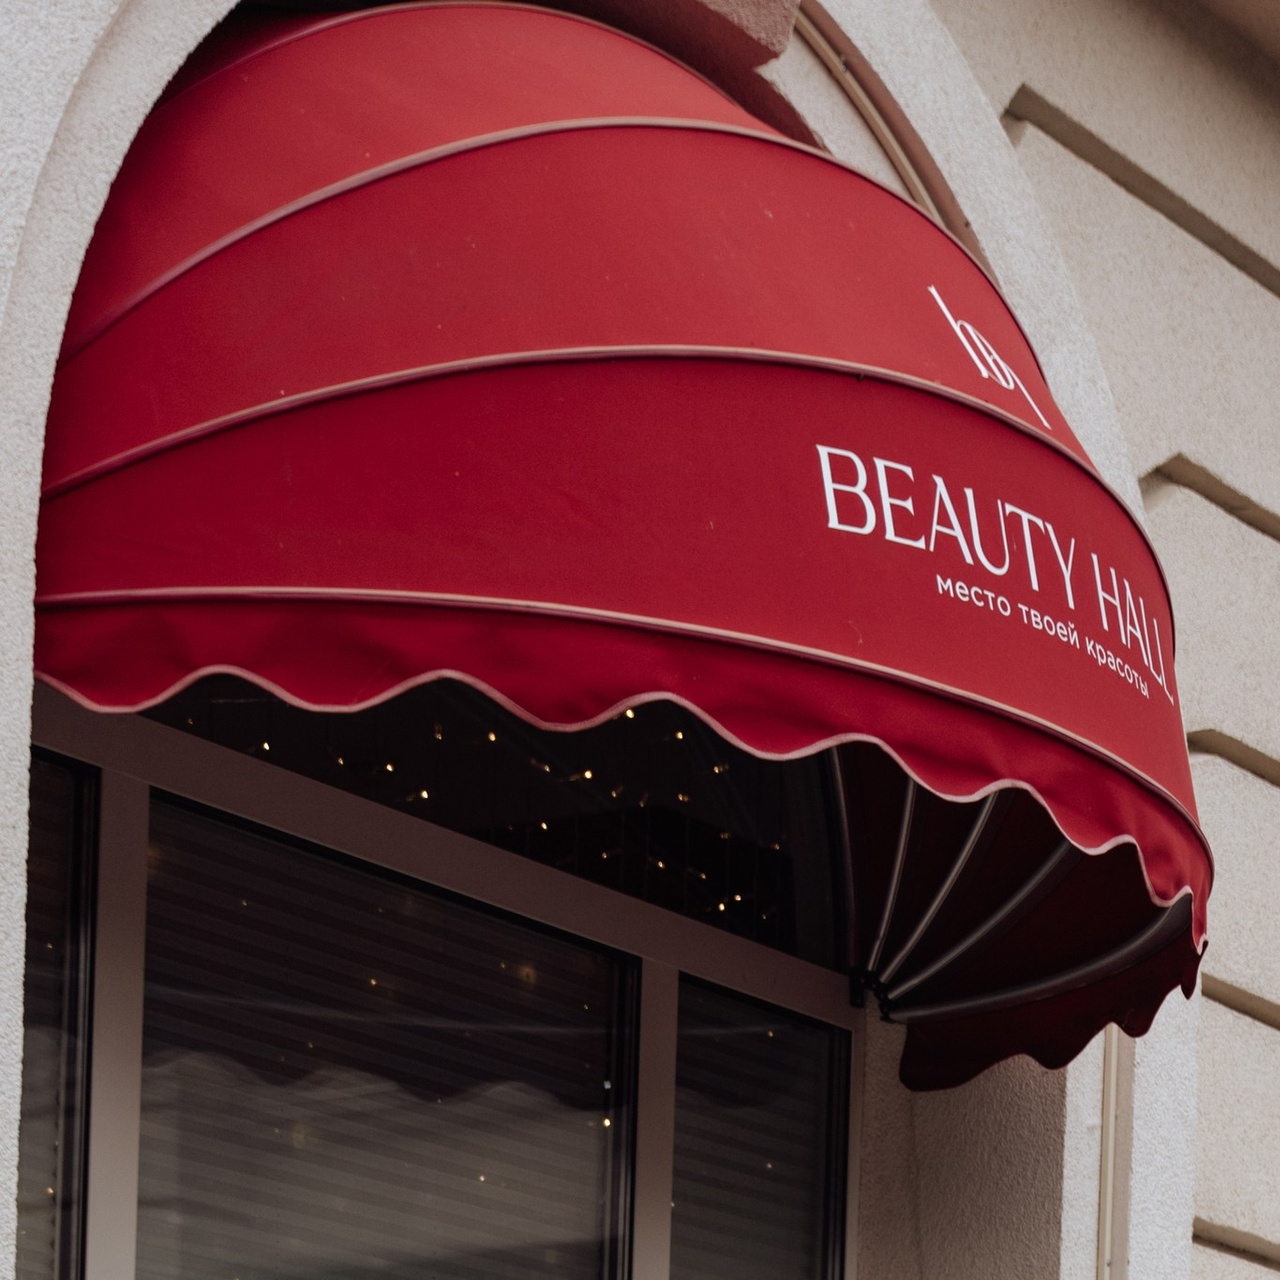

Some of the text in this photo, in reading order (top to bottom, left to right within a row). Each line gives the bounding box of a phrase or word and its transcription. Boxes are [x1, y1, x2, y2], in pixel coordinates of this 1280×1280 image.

[815, 443, 1175, 707] BEAUTY HALL
[935, 573, 1150, 699] место твоей красоты
